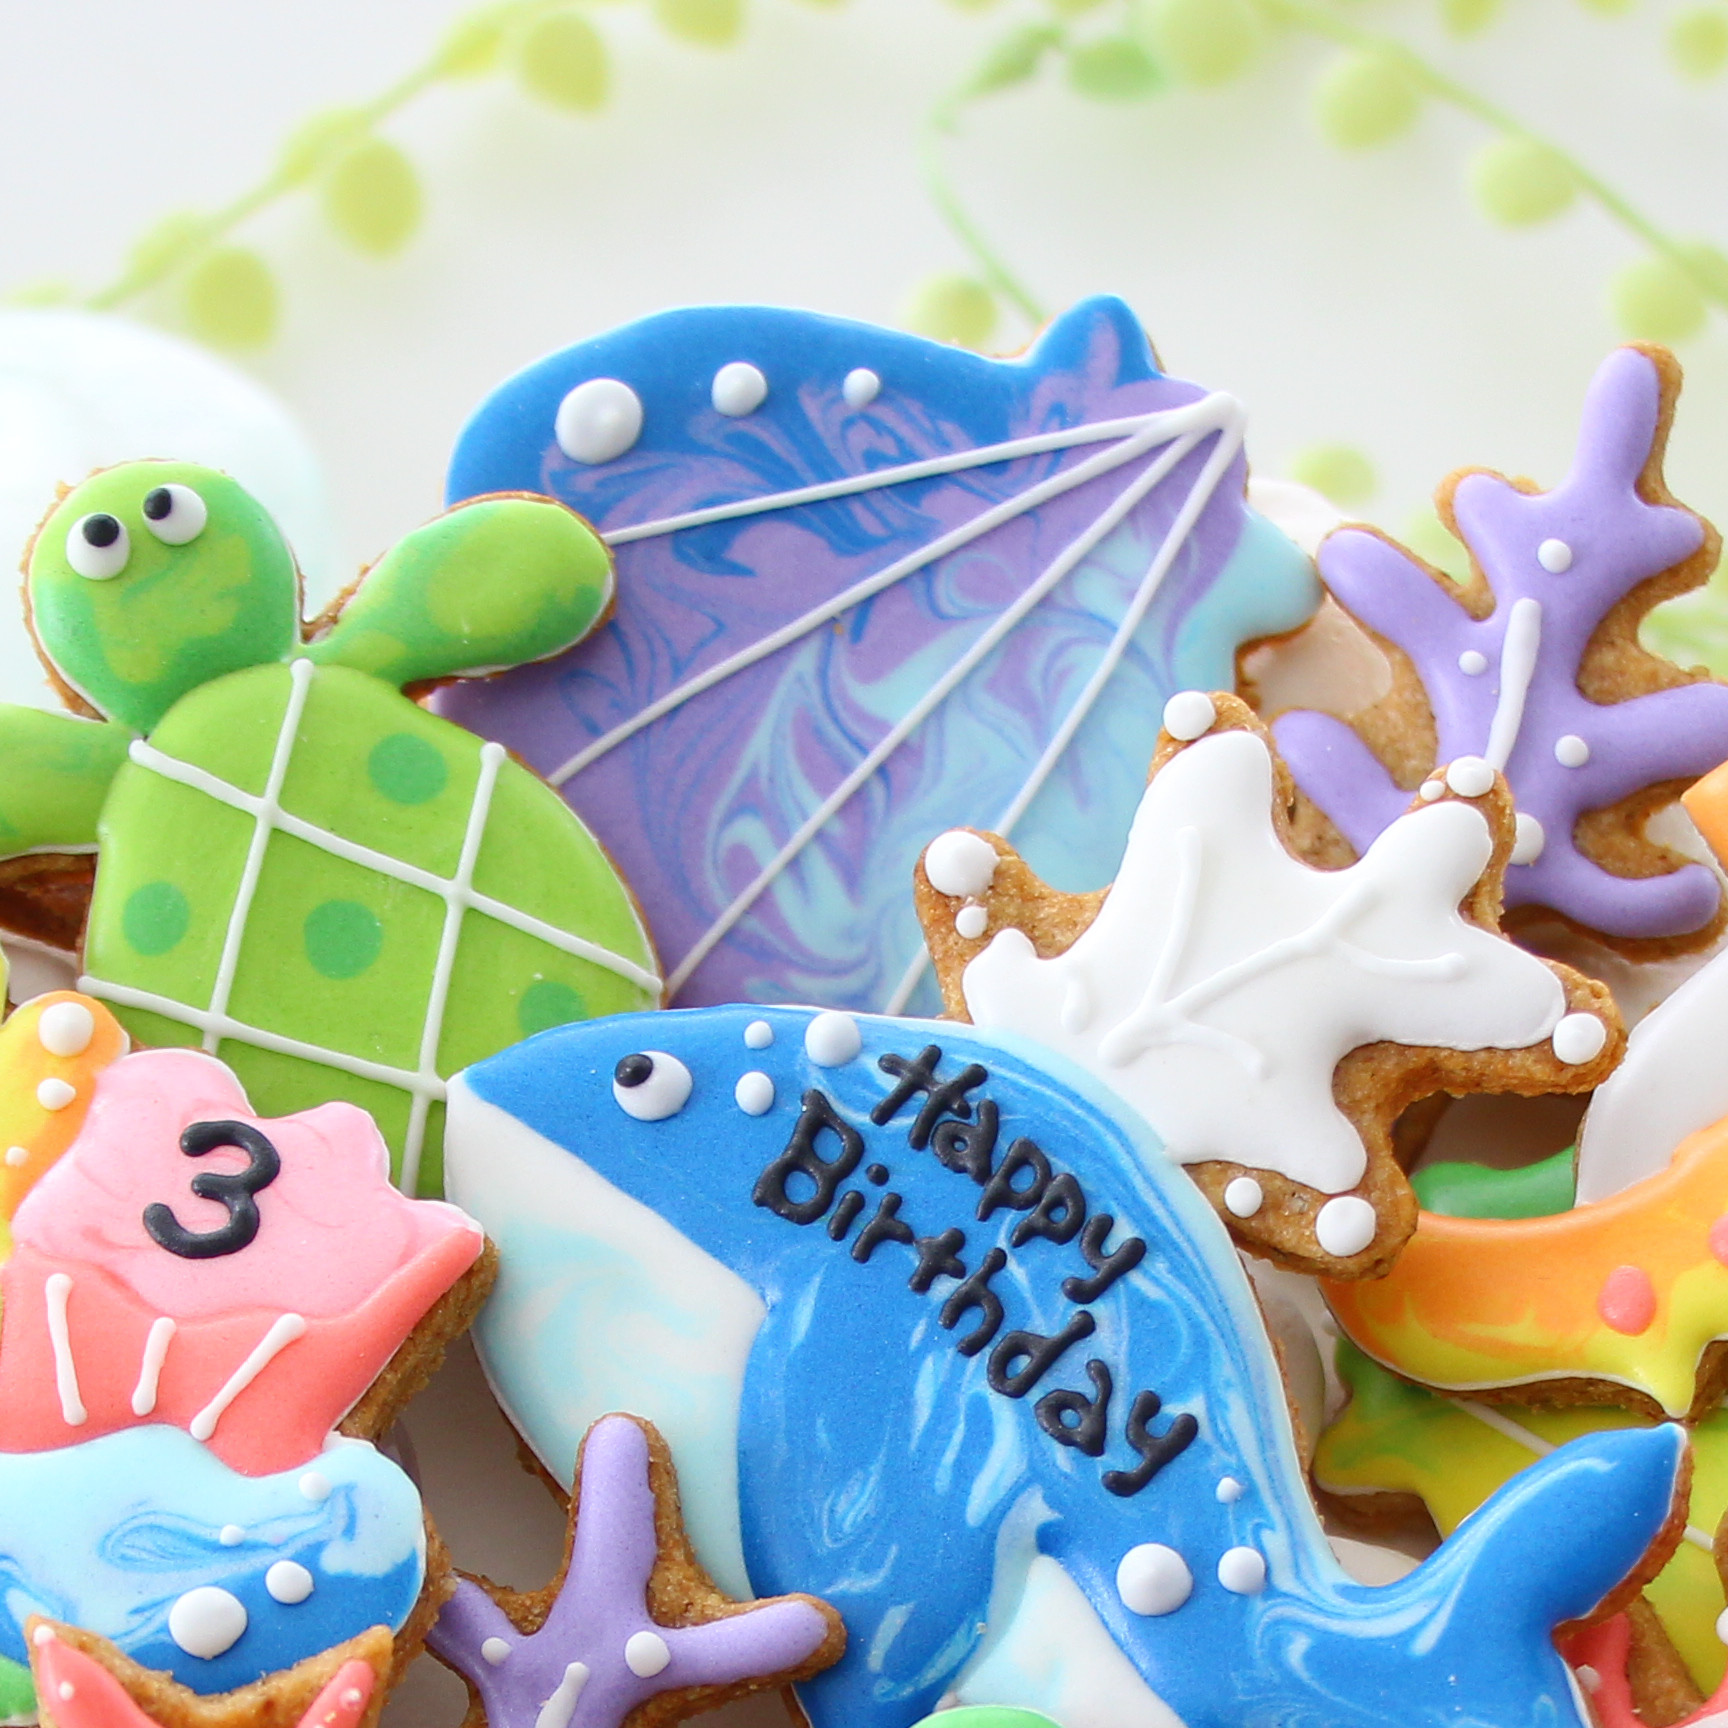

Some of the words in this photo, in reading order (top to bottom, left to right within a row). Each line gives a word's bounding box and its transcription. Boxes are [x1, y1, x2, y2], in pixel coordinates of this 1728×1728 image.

[141, 1119, 281, 1260] 3
[752, 1088, 1199, 1497] Birthday
[871, 1044, 1147, 1304] Happy
